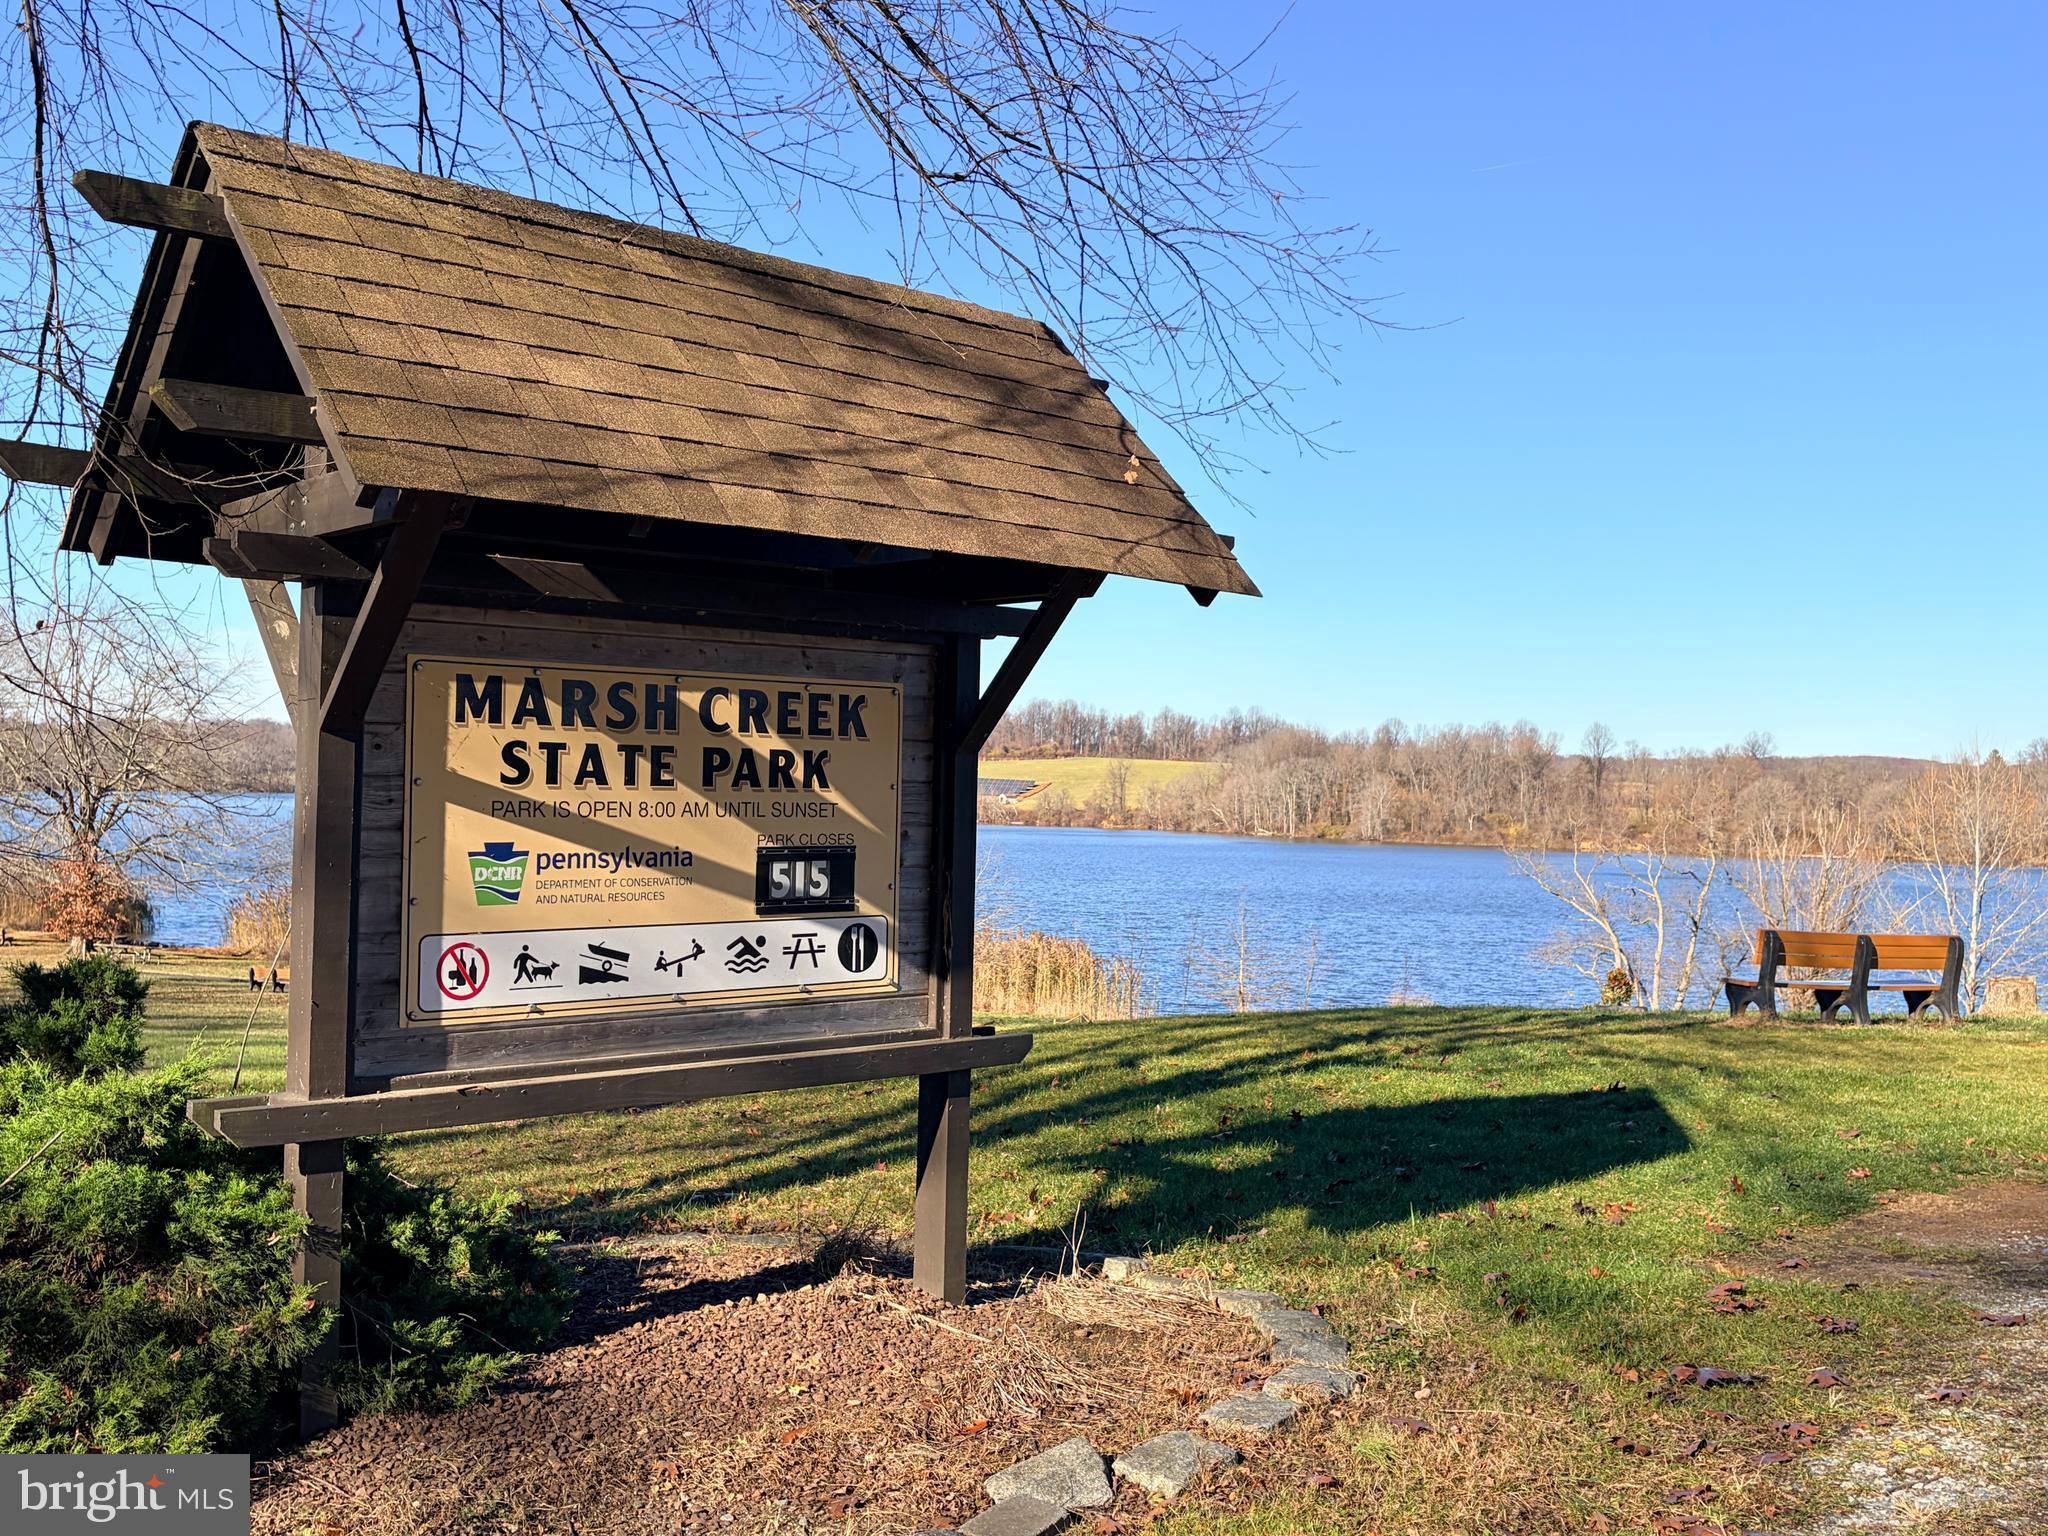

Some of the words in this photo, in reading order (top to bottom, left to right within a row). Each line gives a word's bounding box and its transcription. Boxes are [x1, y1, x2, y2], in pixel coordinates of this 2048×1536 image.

[454, 673, 680, 734] MARSH
[699, 686, 869, 740] CREEK
[500, 740, 677, 789] STATE
[702, 746, 832, 792] PARK
[491, 800, 546, 818] PARK
[553, 800, 571, 818] IS
[577, 801, 632, 818] OPEN
[638, 801, 676, 818] 8:00
[681, 802, 710, 818] AM
[715, 802, 767, 818] UNTIL
[771, 802, 839, 818] SUNSET
[757, 833, 795, 846] PARK
[799, 833, 855, 846] CLOSES
[536, 846, 694, 876] pennsylvania
[474, 865, 523, 882] DCNR
[535, 878, 600, 890] DEPARTMENT
[604, 878, 617, 888] OF
[620, 876, 694, 888] CONSERVATION
[535, 894, 558, 905] AND
[560, 893, 606, 905] NATURAL
[608, 891, 666, 902] RESOURCES
